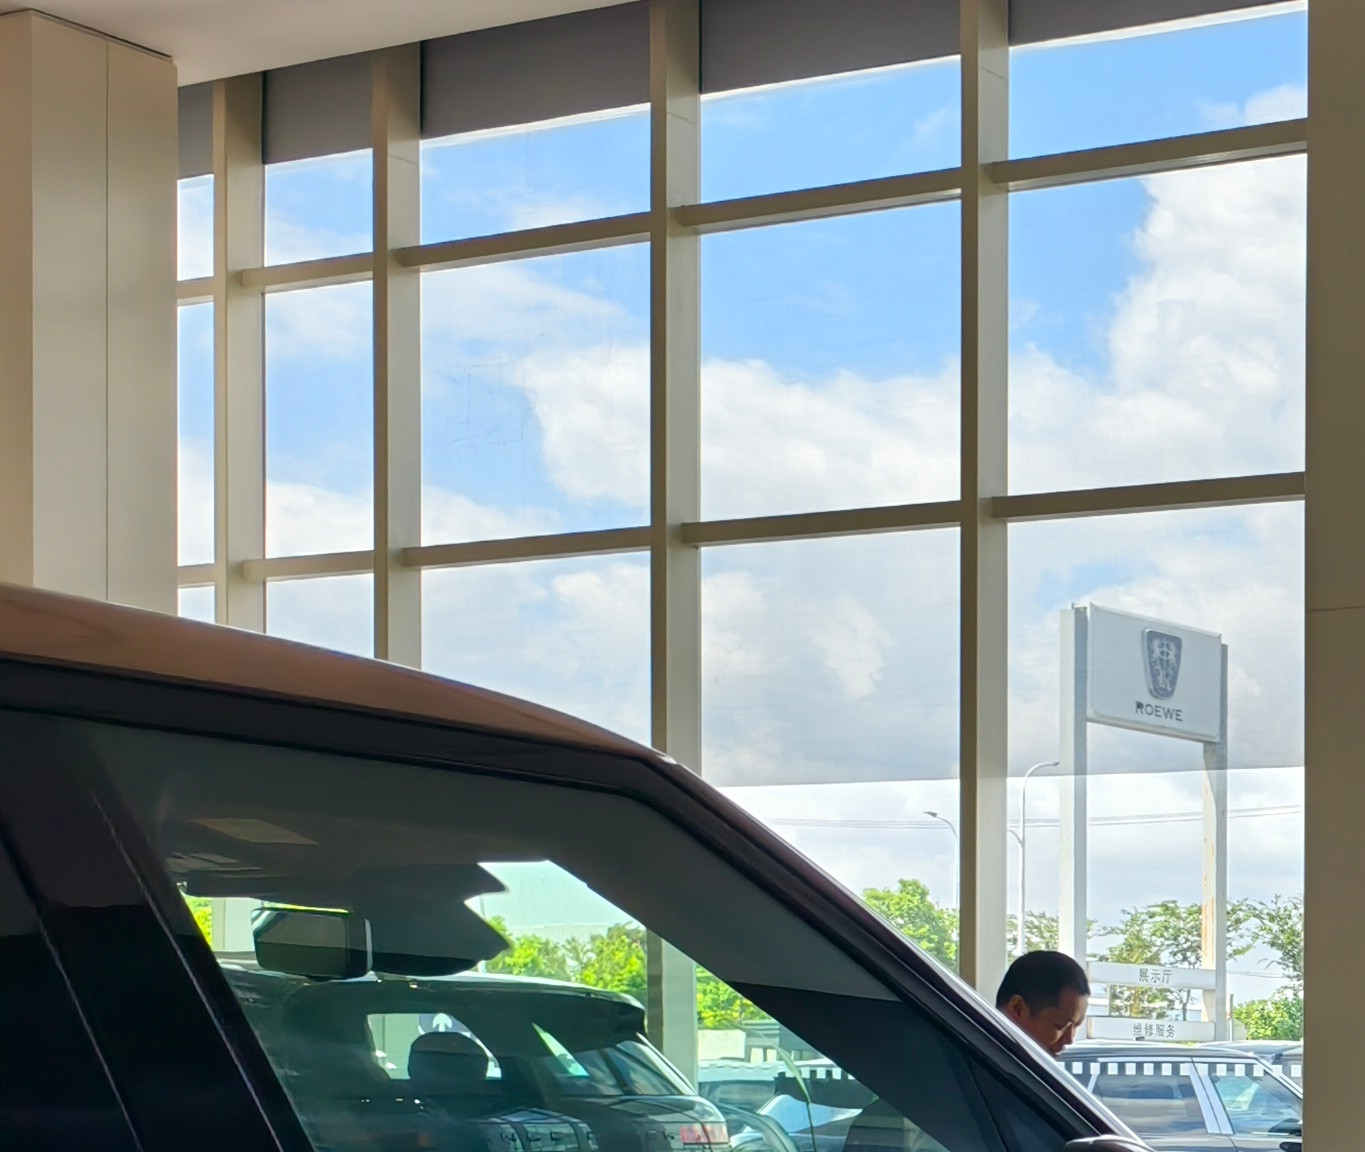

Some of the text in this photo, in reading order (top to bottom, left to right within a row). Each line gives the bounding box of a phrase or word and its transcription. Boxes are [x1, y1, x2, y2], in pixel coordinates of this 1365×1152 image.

[1135, 700, 1183, 722] ROEWE
[1139, 968, 1172, 984] 展示厅
[1133, 1022, 1176, 1038] 维修服务
